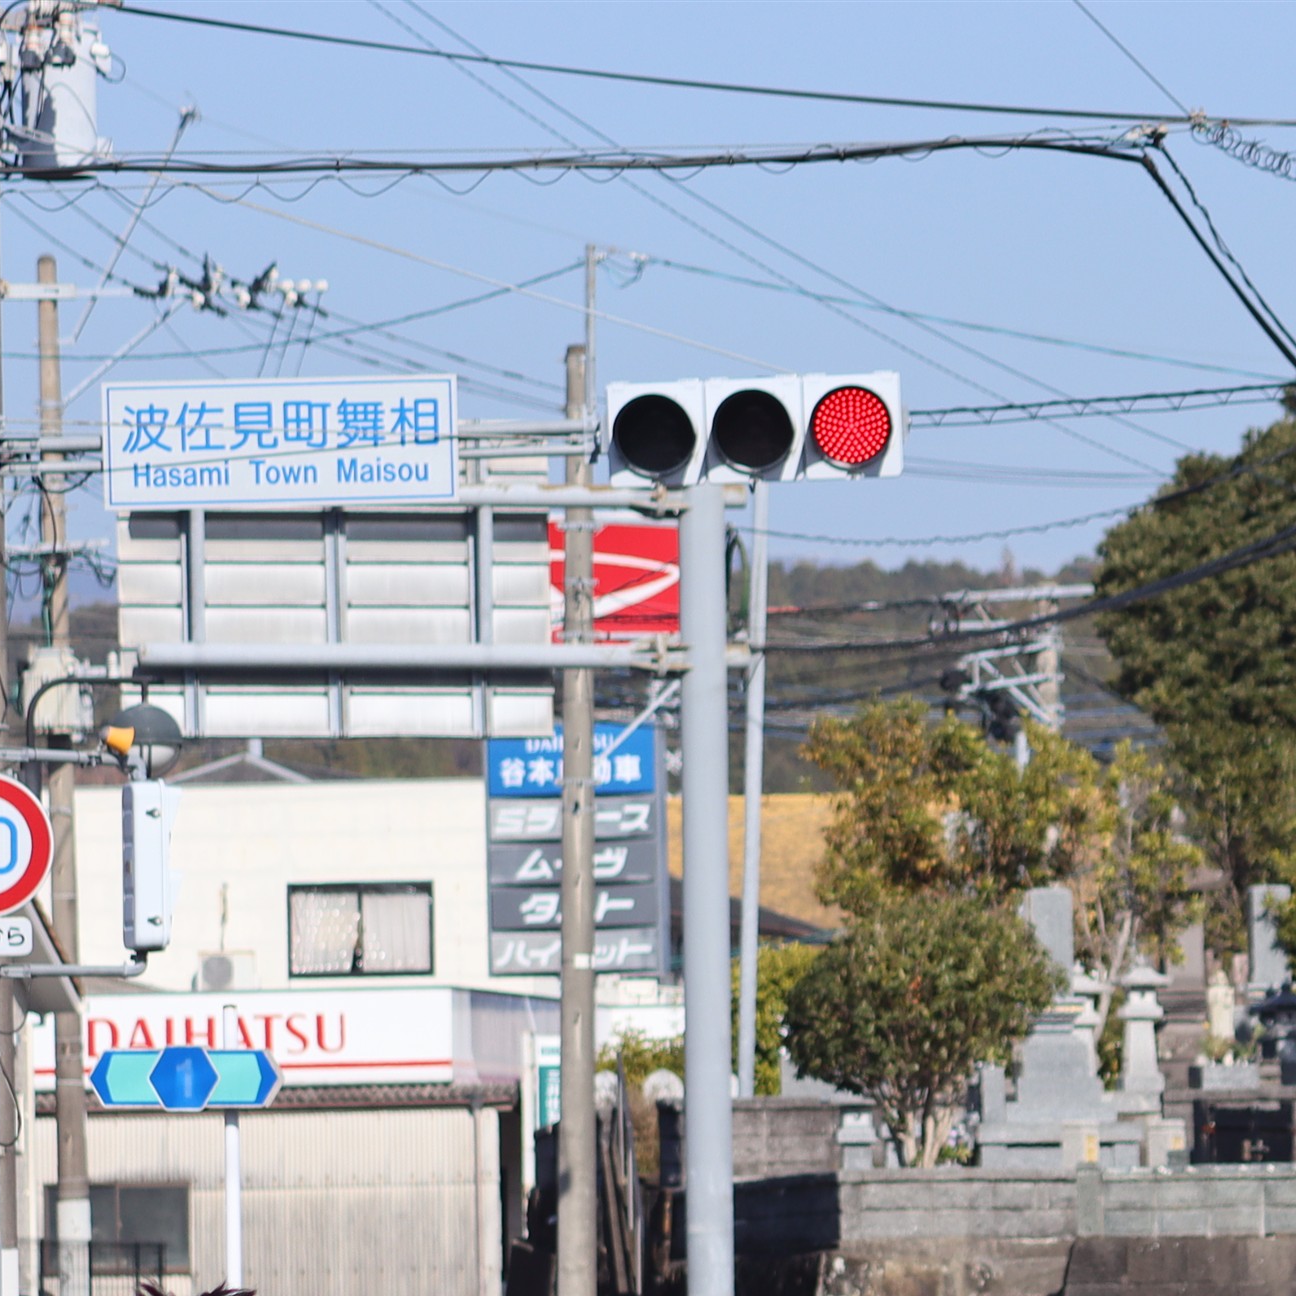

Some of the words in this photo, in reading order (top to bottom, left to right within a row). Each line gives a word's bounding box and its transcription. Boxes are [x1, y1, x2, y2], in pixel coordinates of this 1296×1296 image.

[122, 396, 440, 453] 波佐見町舞相
[133, 460, 230, 487] Hasami
[250, 459, 318, 486] Town
[337, 457, 429, 484] Maisou
[500, 754, 641, 787] 谷本動車
[495, 804, 650, 835] ミラース
[516, 847, 628, 880] ムヴ
[520, 892, 635, 924] タト
[495, 938, 653, 967] ハイット
[87, 1012, 345, 1057] DAIHATSU
